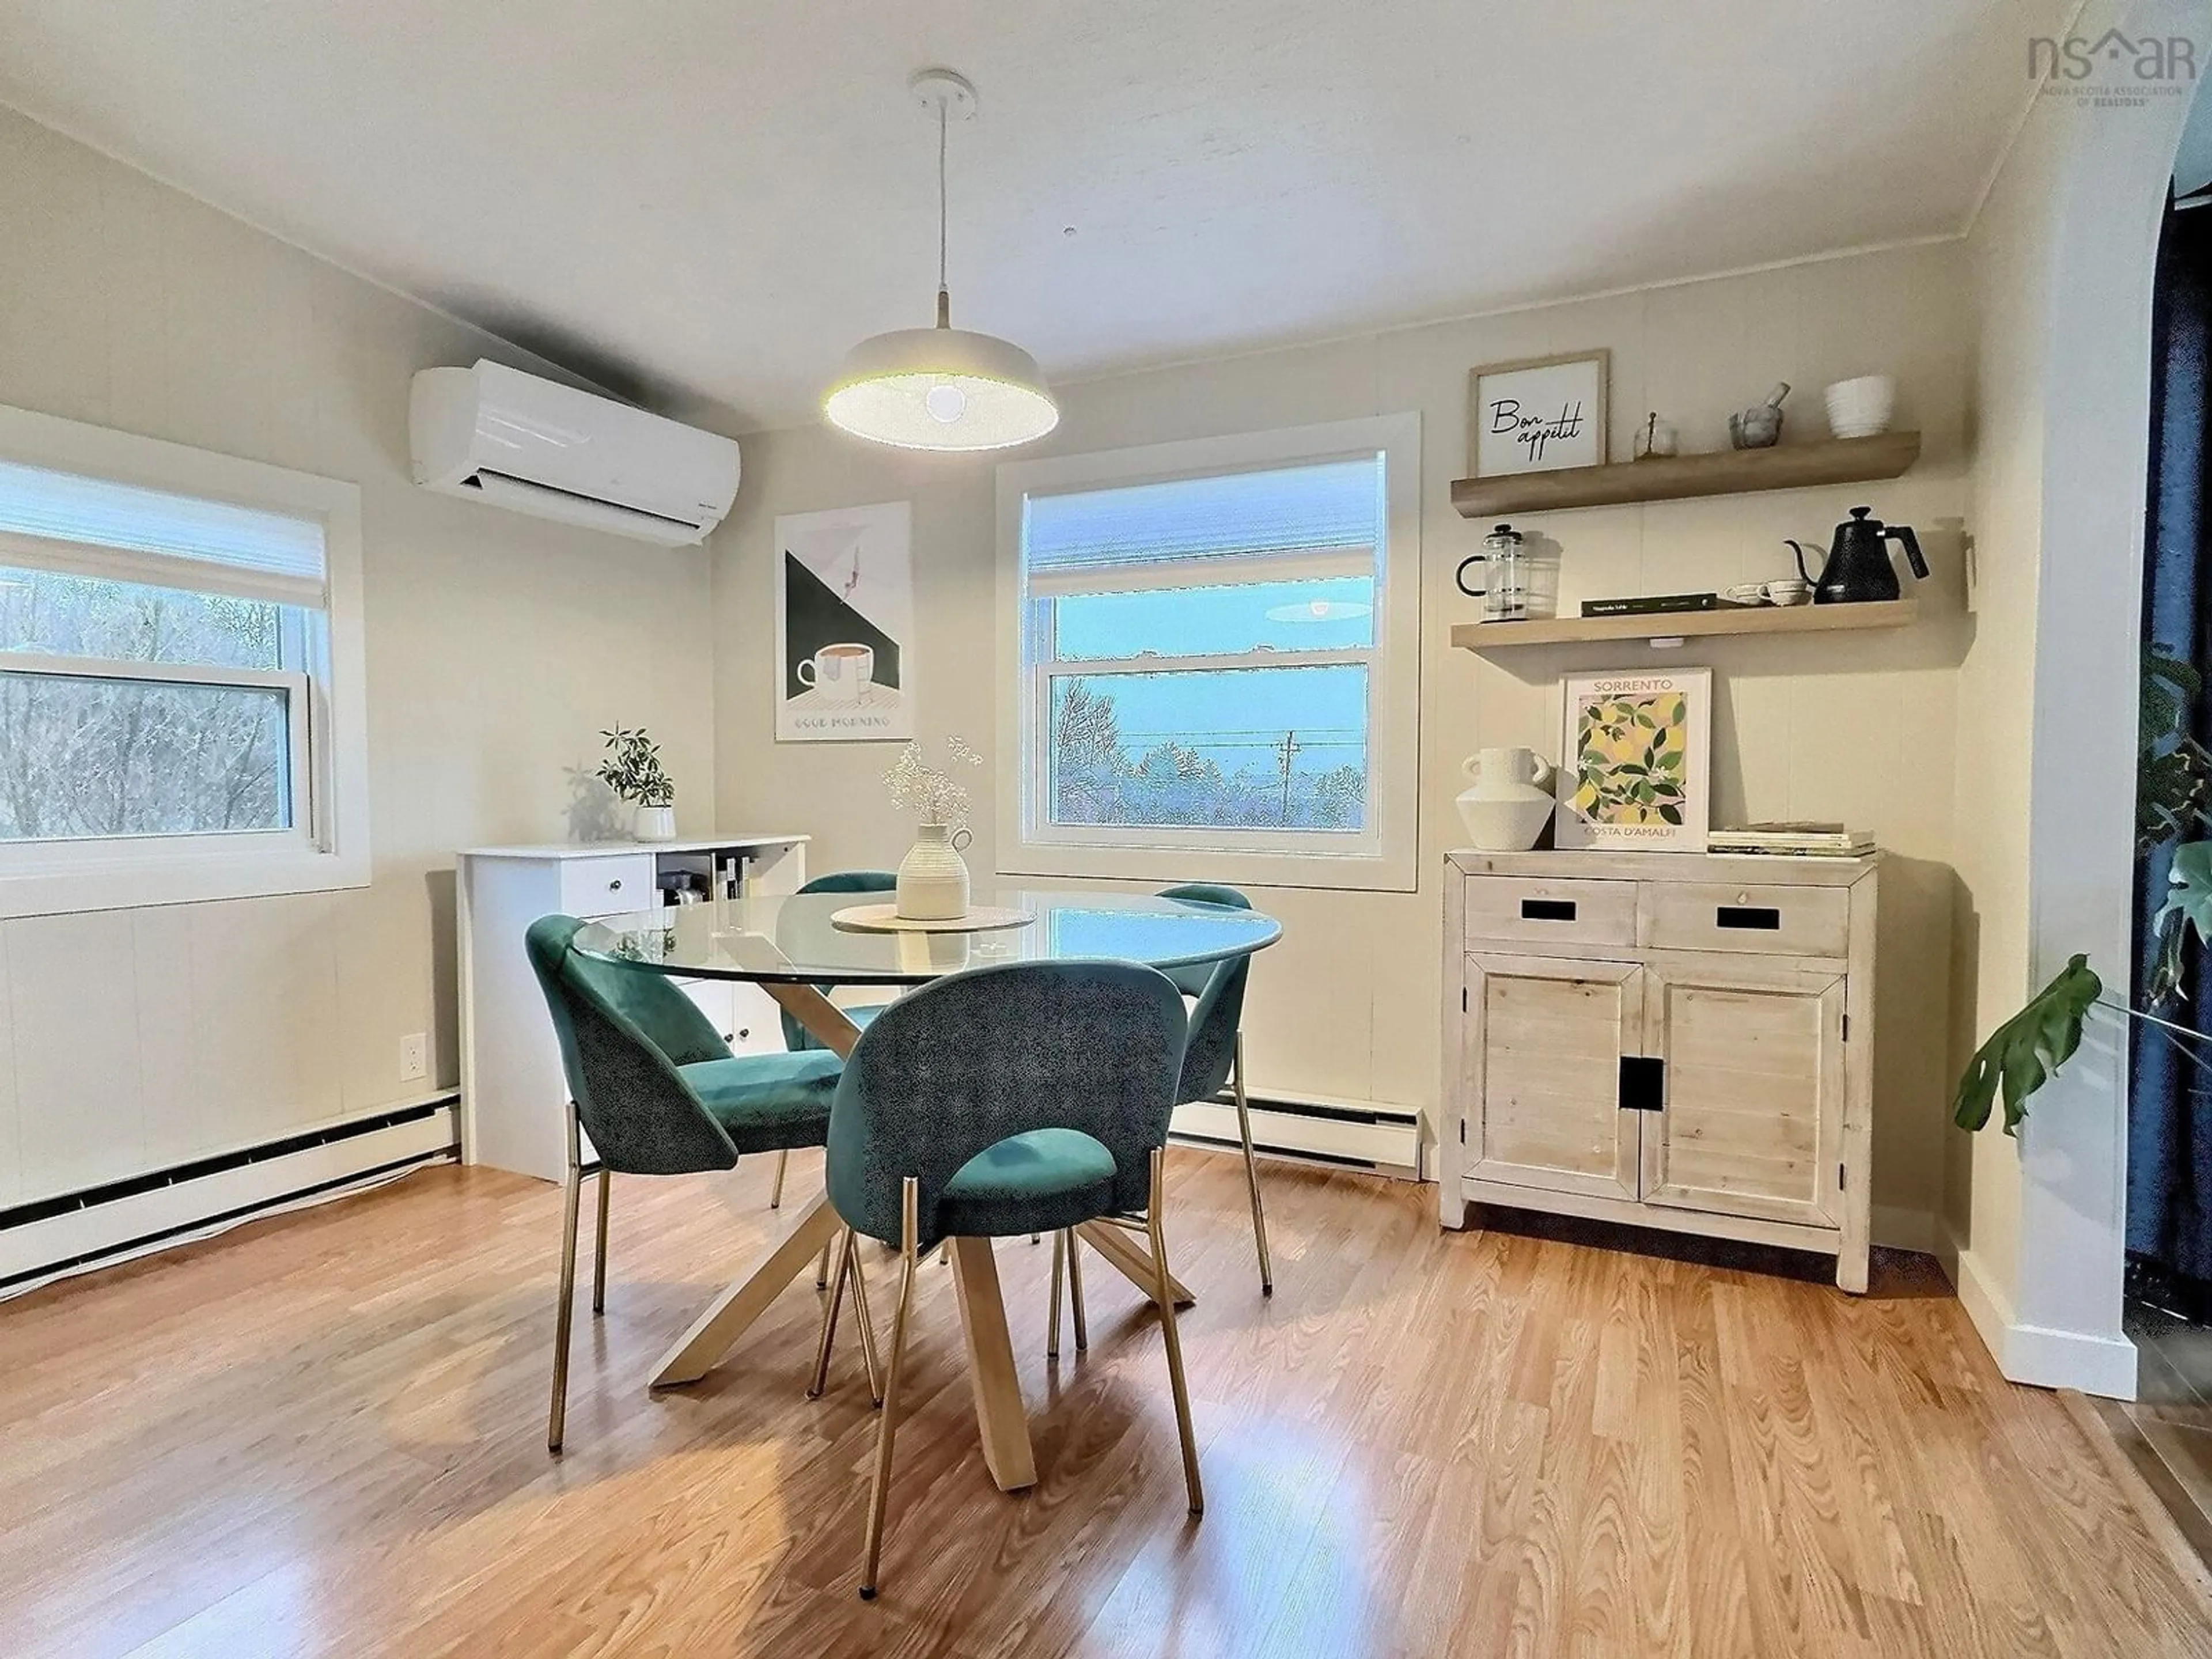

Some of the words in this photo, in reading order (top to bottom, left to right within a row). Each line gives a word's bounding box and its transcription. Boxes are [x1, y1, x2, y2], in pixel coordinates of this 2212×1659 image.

[1490, 400, 1543, 433] Bon
[1594, 679, 1673, 691] SORRENTO
[1585, 827, 1621, 835] COSTA
[1624, 828, 1675, 836] D'AMALFI
